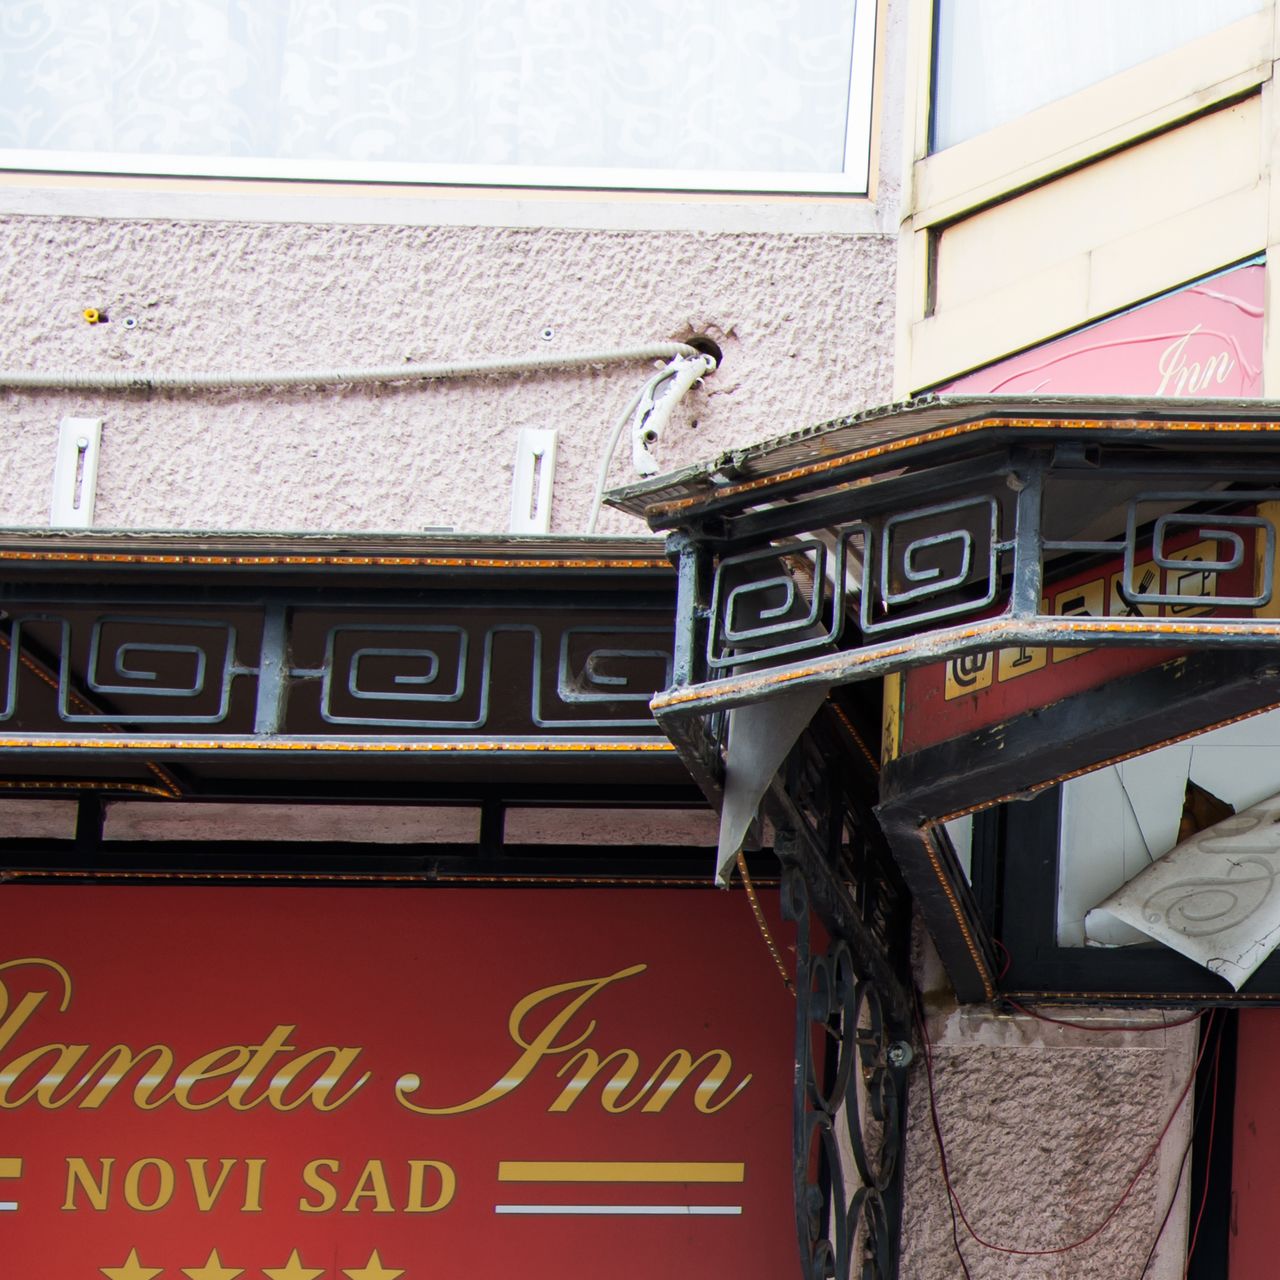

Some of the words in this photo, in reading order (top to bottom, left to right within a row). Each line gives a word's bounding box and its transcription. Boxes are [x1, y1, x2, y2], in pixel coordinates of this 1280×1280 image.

[394, 963, 754, 1115] Inn
[60, 1157, 268, 1213] NOVI
[298, 1158, 458, 1214] SAD
